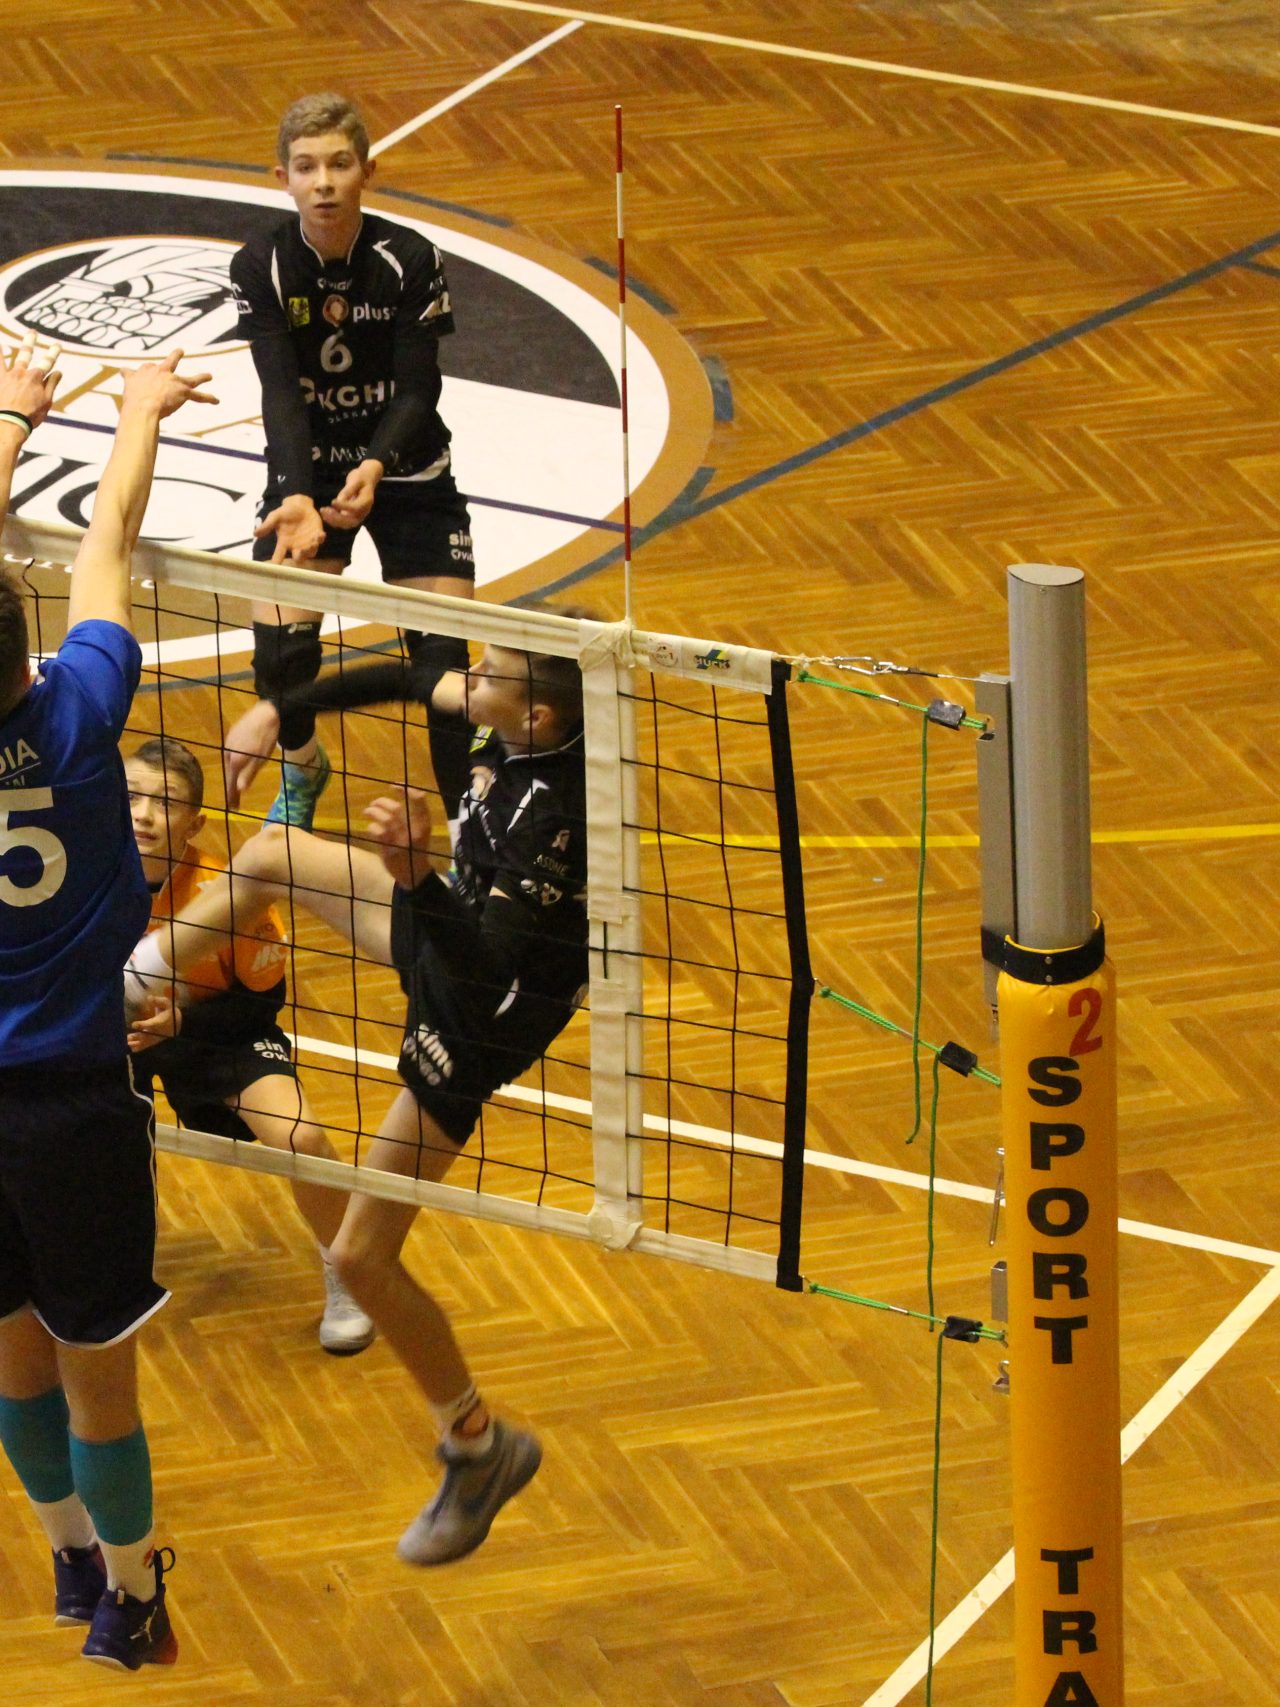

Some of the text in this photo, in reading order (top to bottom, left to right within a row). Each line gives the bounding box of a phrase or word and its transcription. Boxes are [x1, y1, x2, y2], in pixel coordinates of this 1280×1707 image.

[352, 303, 392, 323] plus
[320, 331, 353, 373] 6
[1067, 987, 1104, 1057] 2
[1026, 1055, 1091, 1366] SPORT
